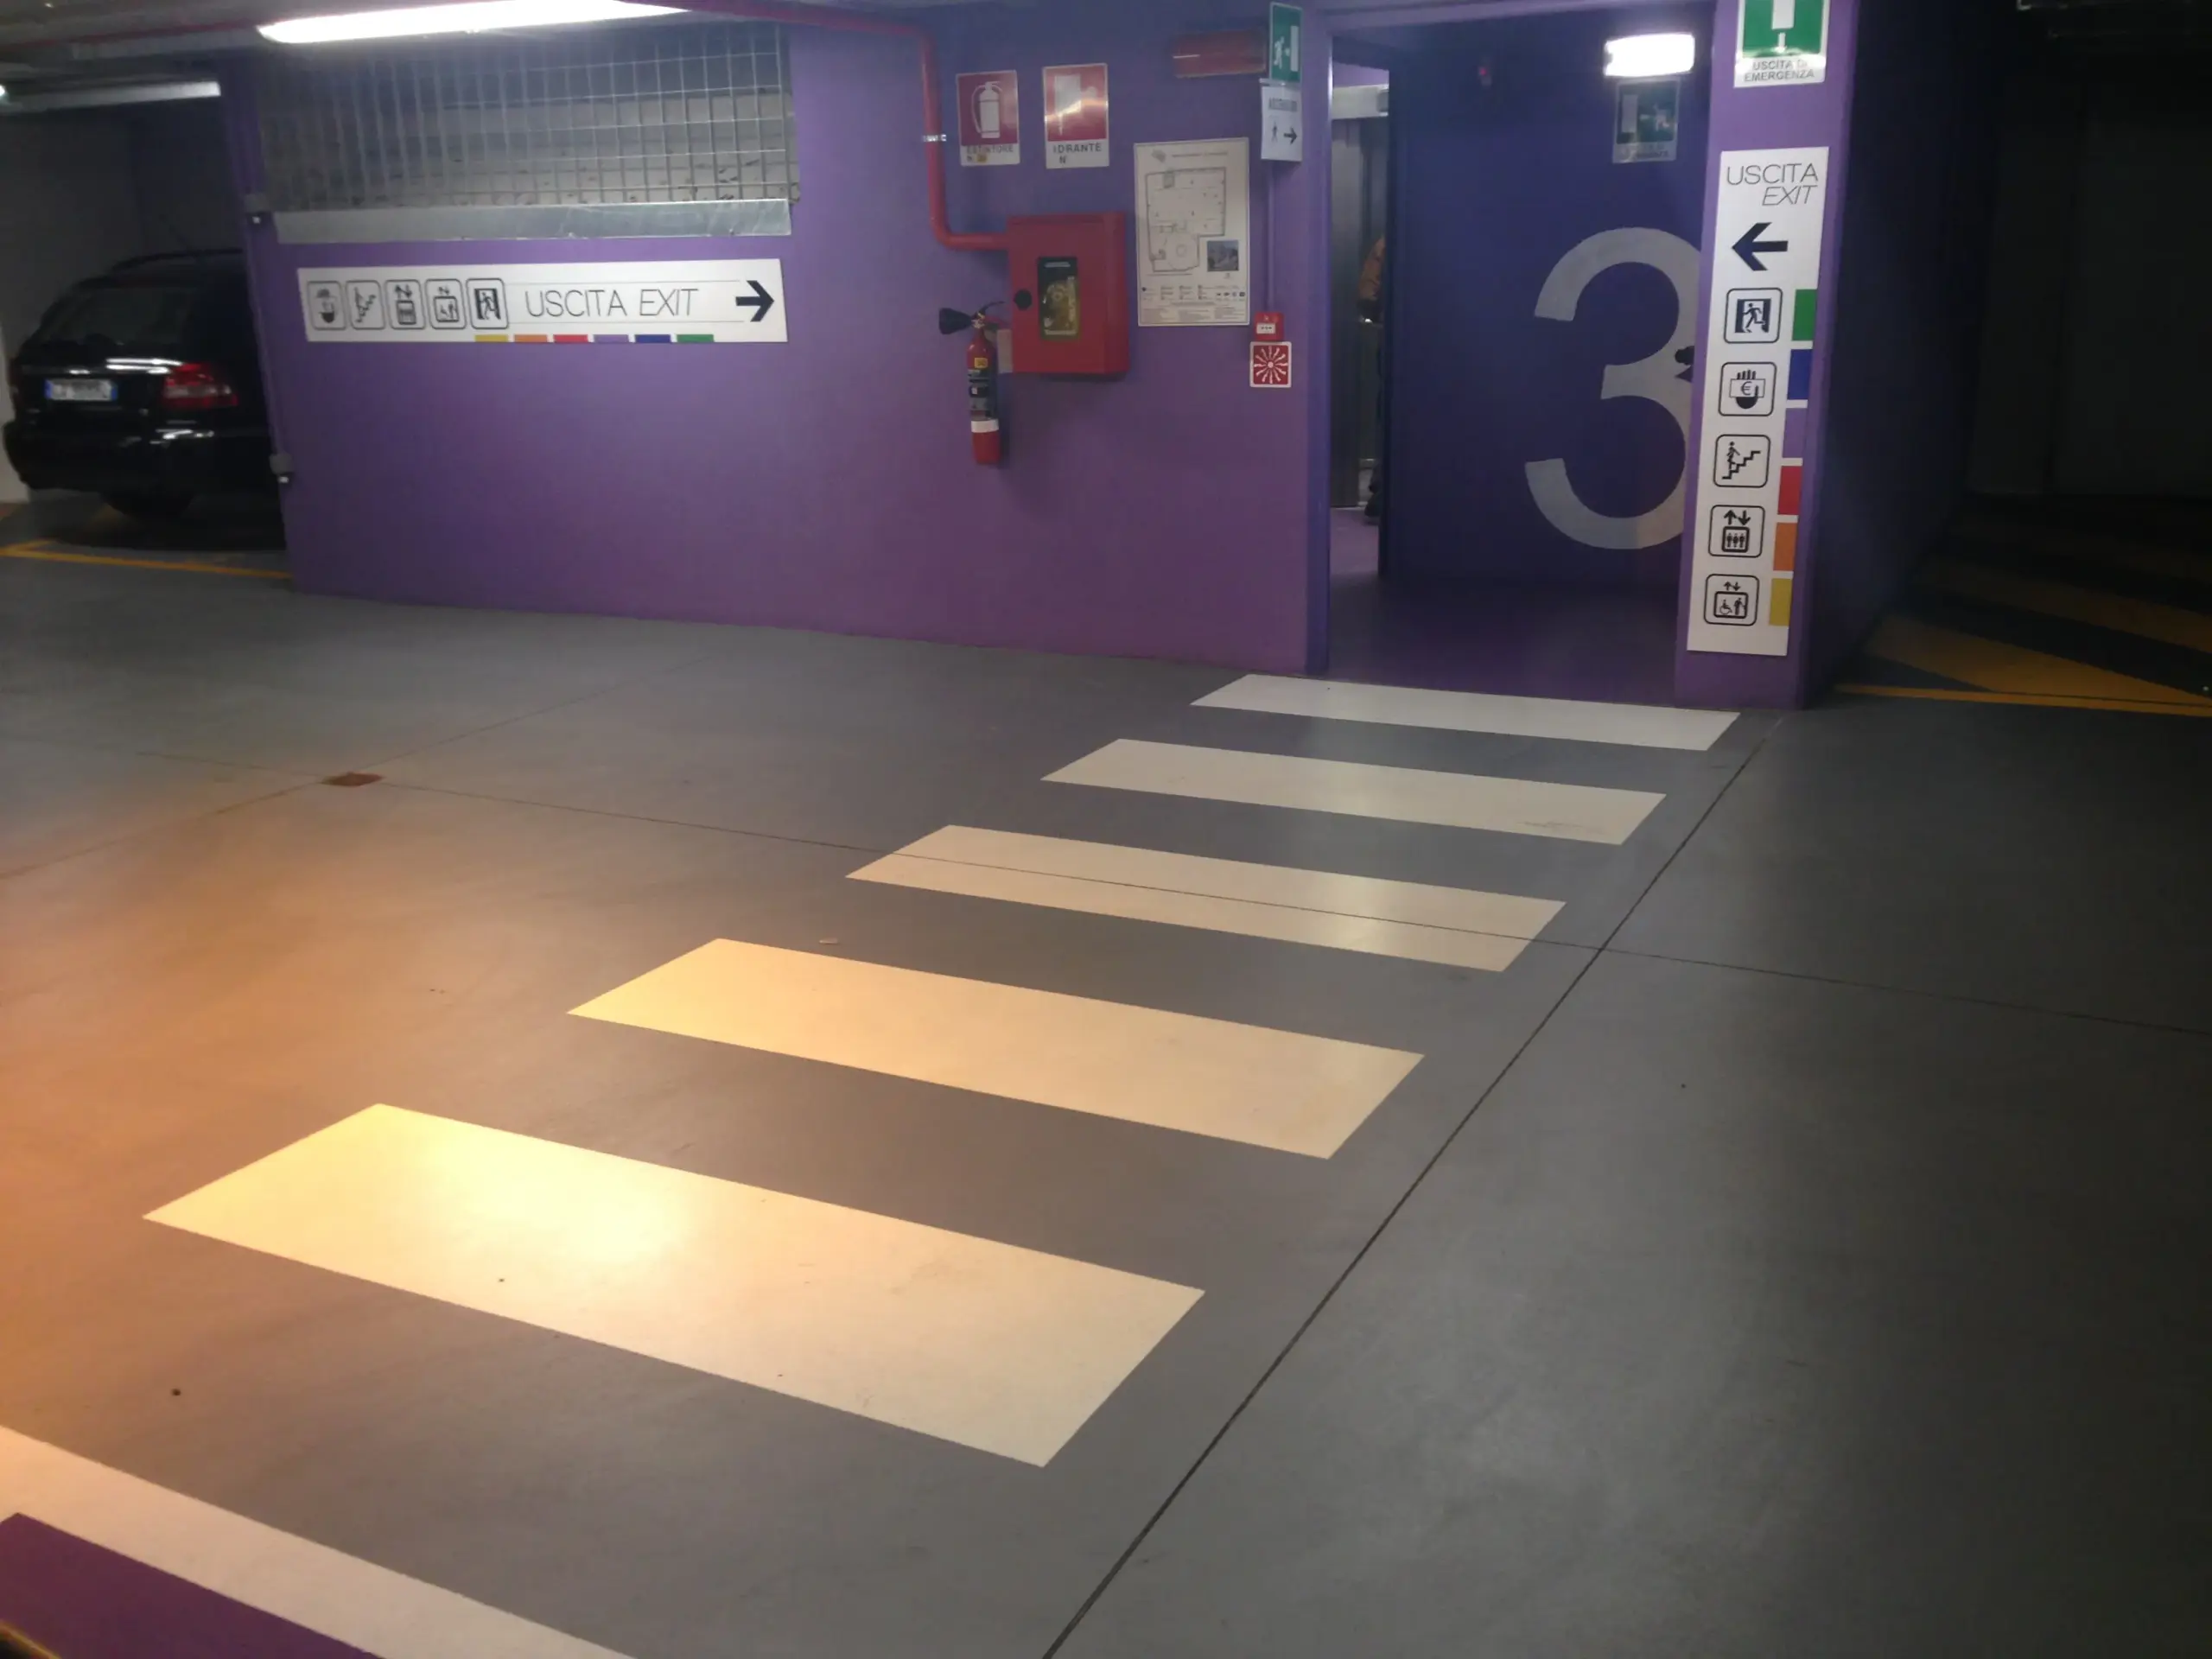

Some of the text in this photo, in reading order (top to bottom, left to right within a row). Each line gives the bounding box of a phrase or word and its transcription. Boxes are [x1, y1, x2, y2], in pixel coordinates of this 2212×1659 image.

[1744, 69, 1815, 82] EMERGENZA
[1752, 59, 1794, 70] USCITA
[1052, 143, 1103, 153] IDRANTE
[1726, 162, 1819, 186] USCITA
[1762, 184, 1819, 207] EXIT
[524, 288, 699, 317] USCITA EXIT
[1524, 226, 1700, 550] 3
